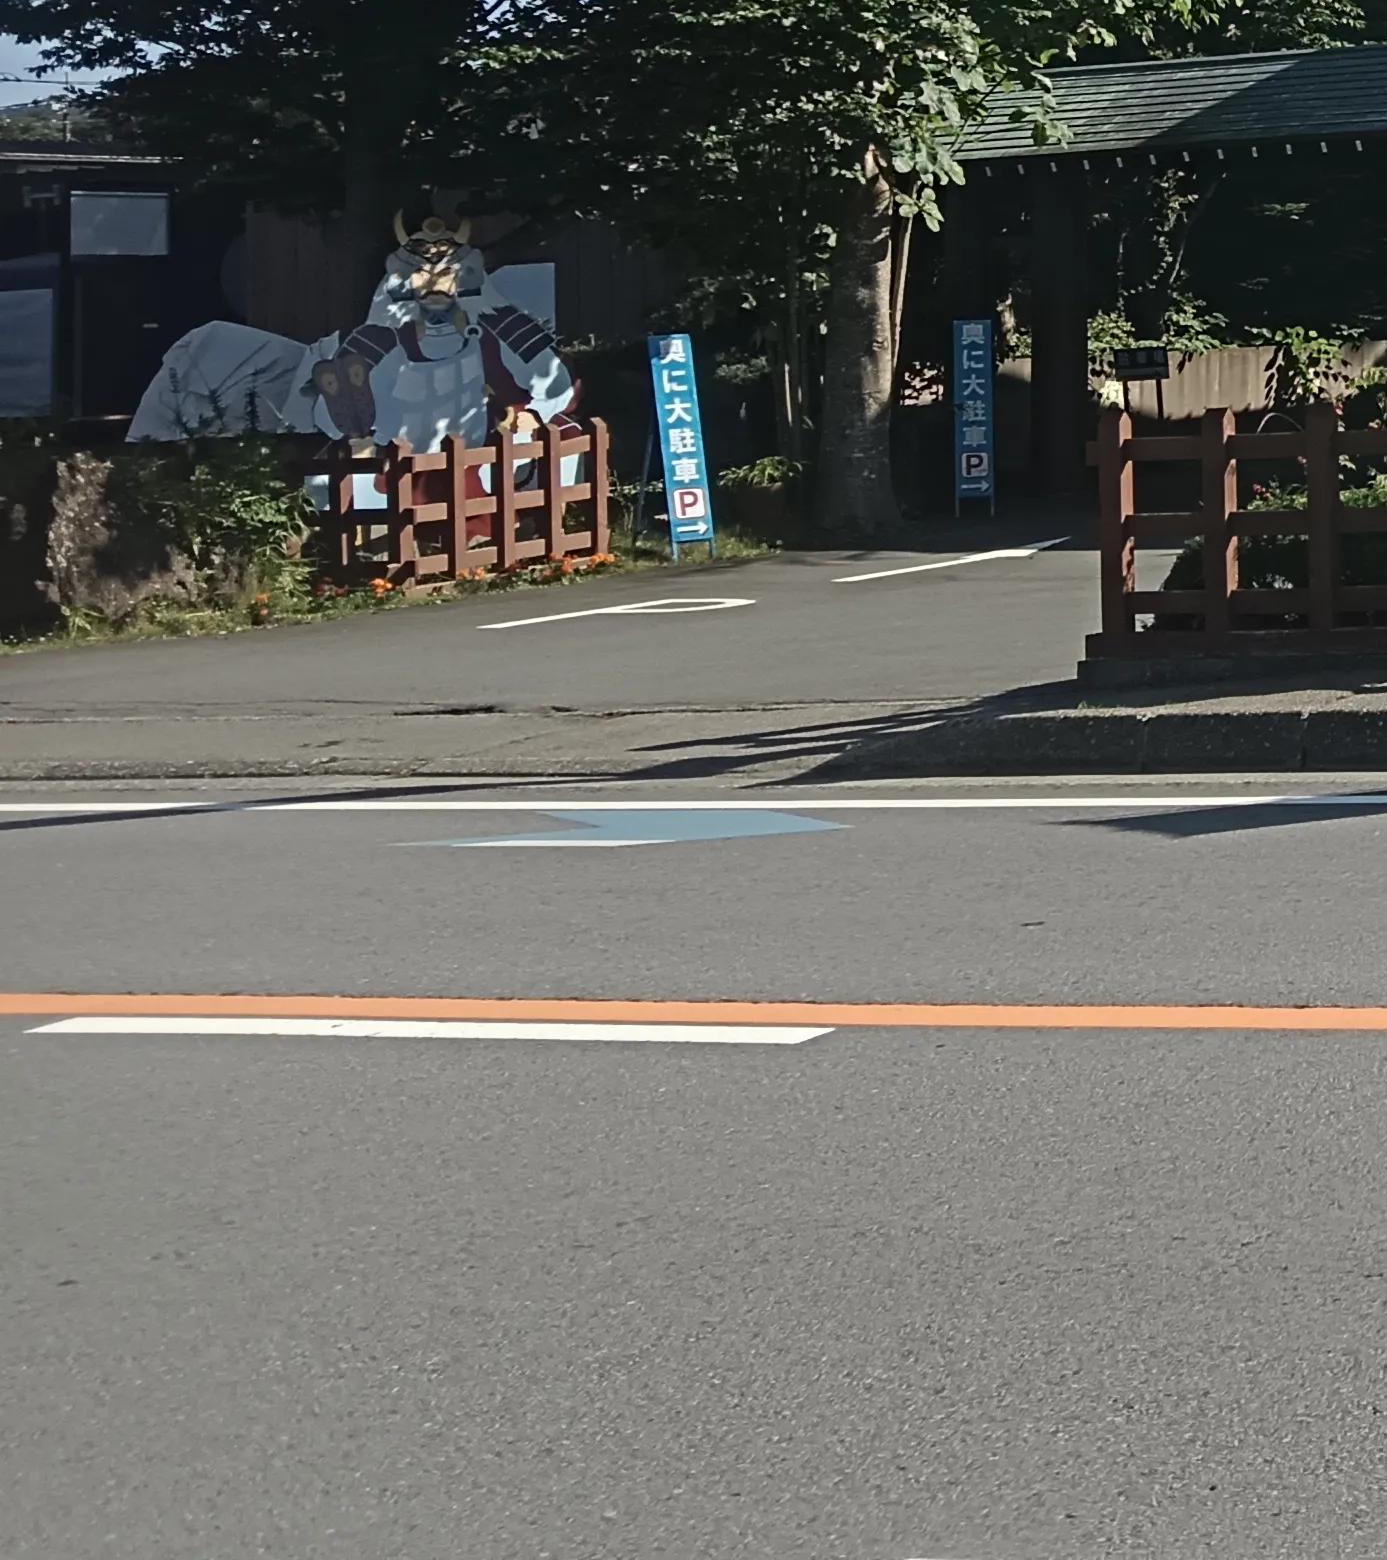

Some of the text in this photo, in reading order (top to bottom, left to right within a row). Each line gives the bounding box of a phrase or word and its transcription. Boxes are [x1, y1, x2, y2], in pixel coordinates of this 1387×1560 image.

[659, 339, 700, 484] 奥に大駐車
[965, 454, 984, 476] P
[678, 490, 699, 517] P
